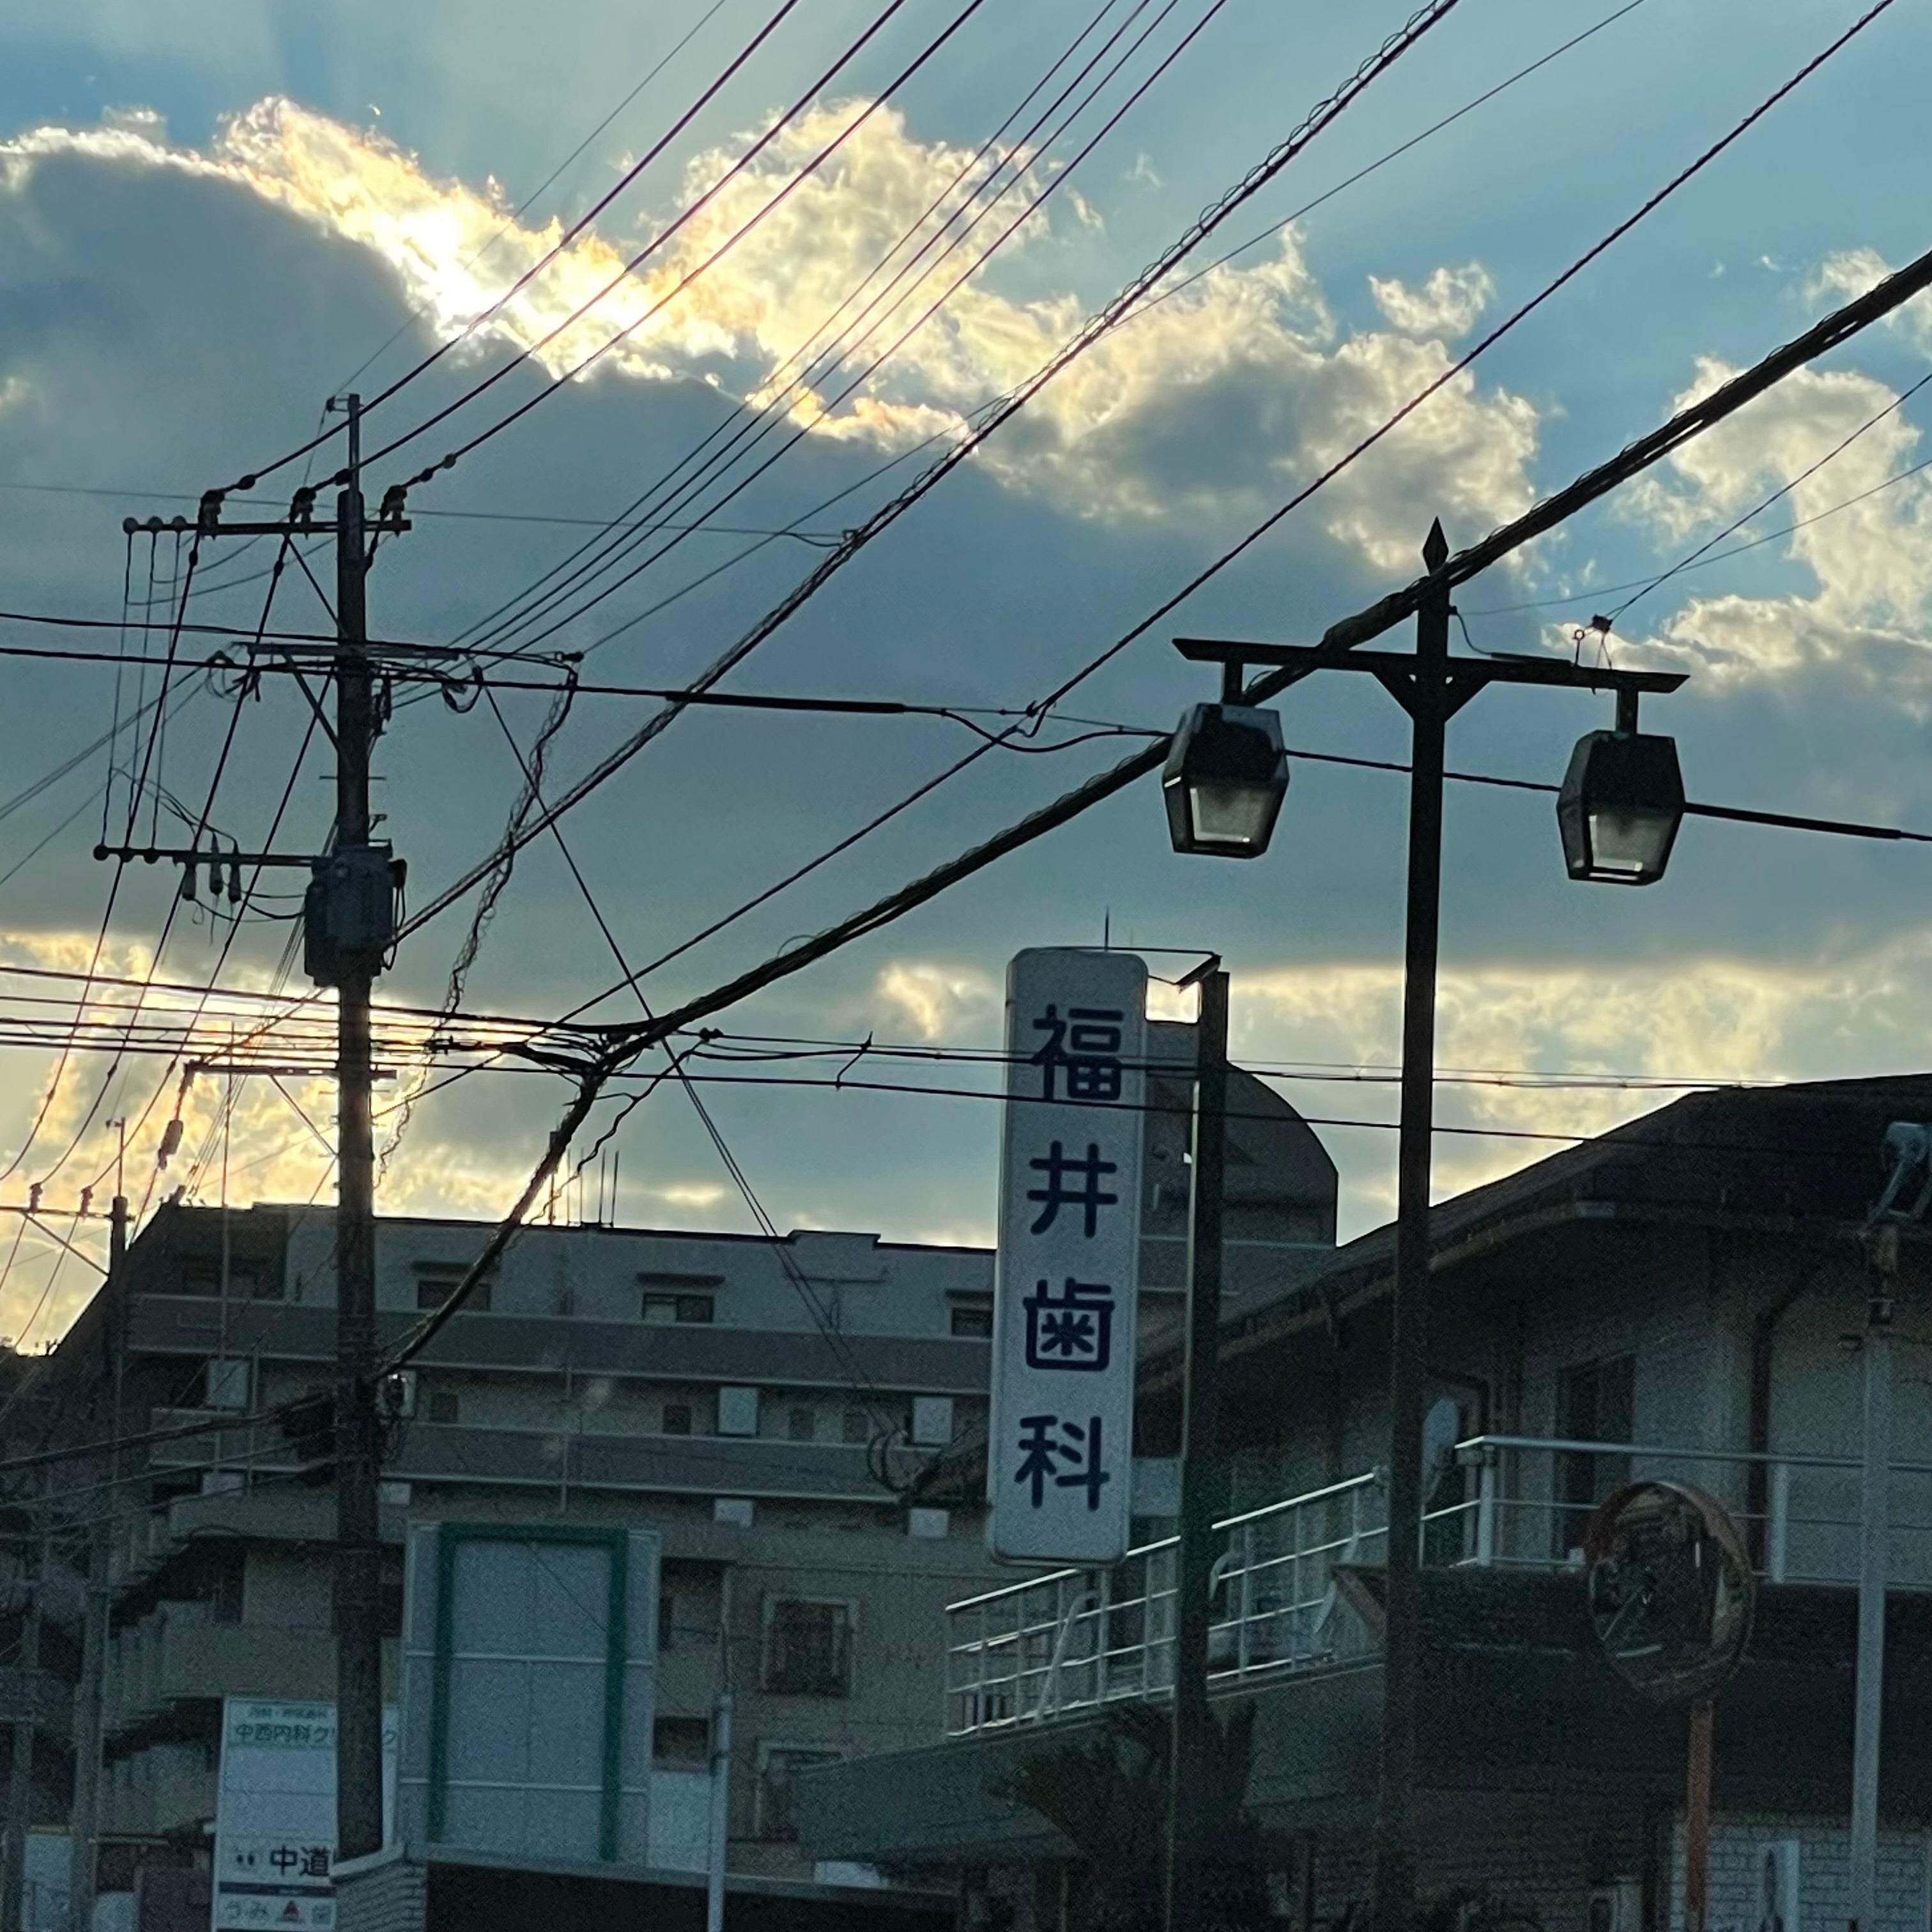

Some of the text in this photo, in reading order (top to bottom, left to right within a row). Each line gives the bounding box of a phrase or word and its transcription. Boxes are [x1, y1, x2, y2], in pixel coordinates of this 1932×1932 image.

[1014, 1003, 1124, 1512] 福井歯科
[236, 1723, 397, 1747] 中西内科クク
[270, 1844, 330, 1877] 中道
